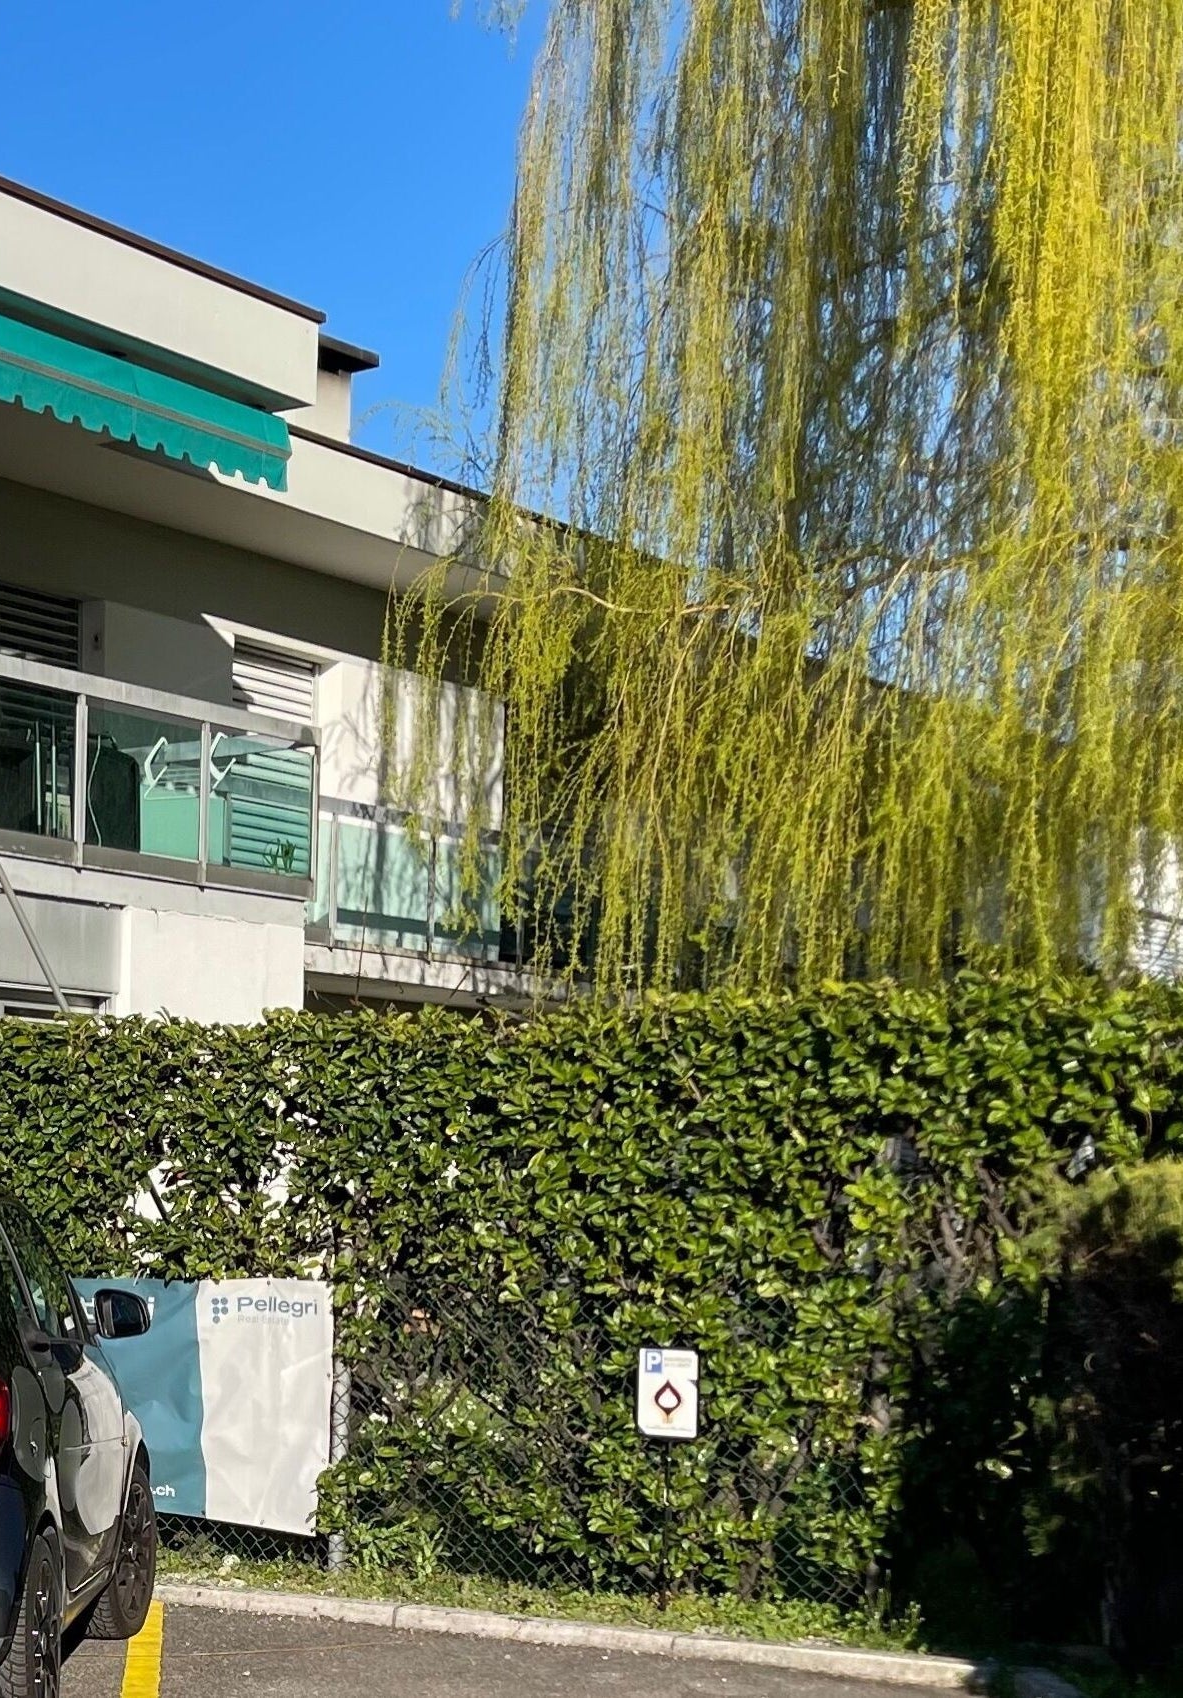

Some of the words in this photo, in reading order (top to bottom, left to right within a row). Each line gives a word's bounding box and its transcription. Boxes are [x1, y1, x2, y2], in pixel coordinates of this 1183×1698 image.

[237, 1296, 318, 1318] Pellegri
[646, 1351, 662, 1371] P
[150, 1484, 176, 1498] .ch
